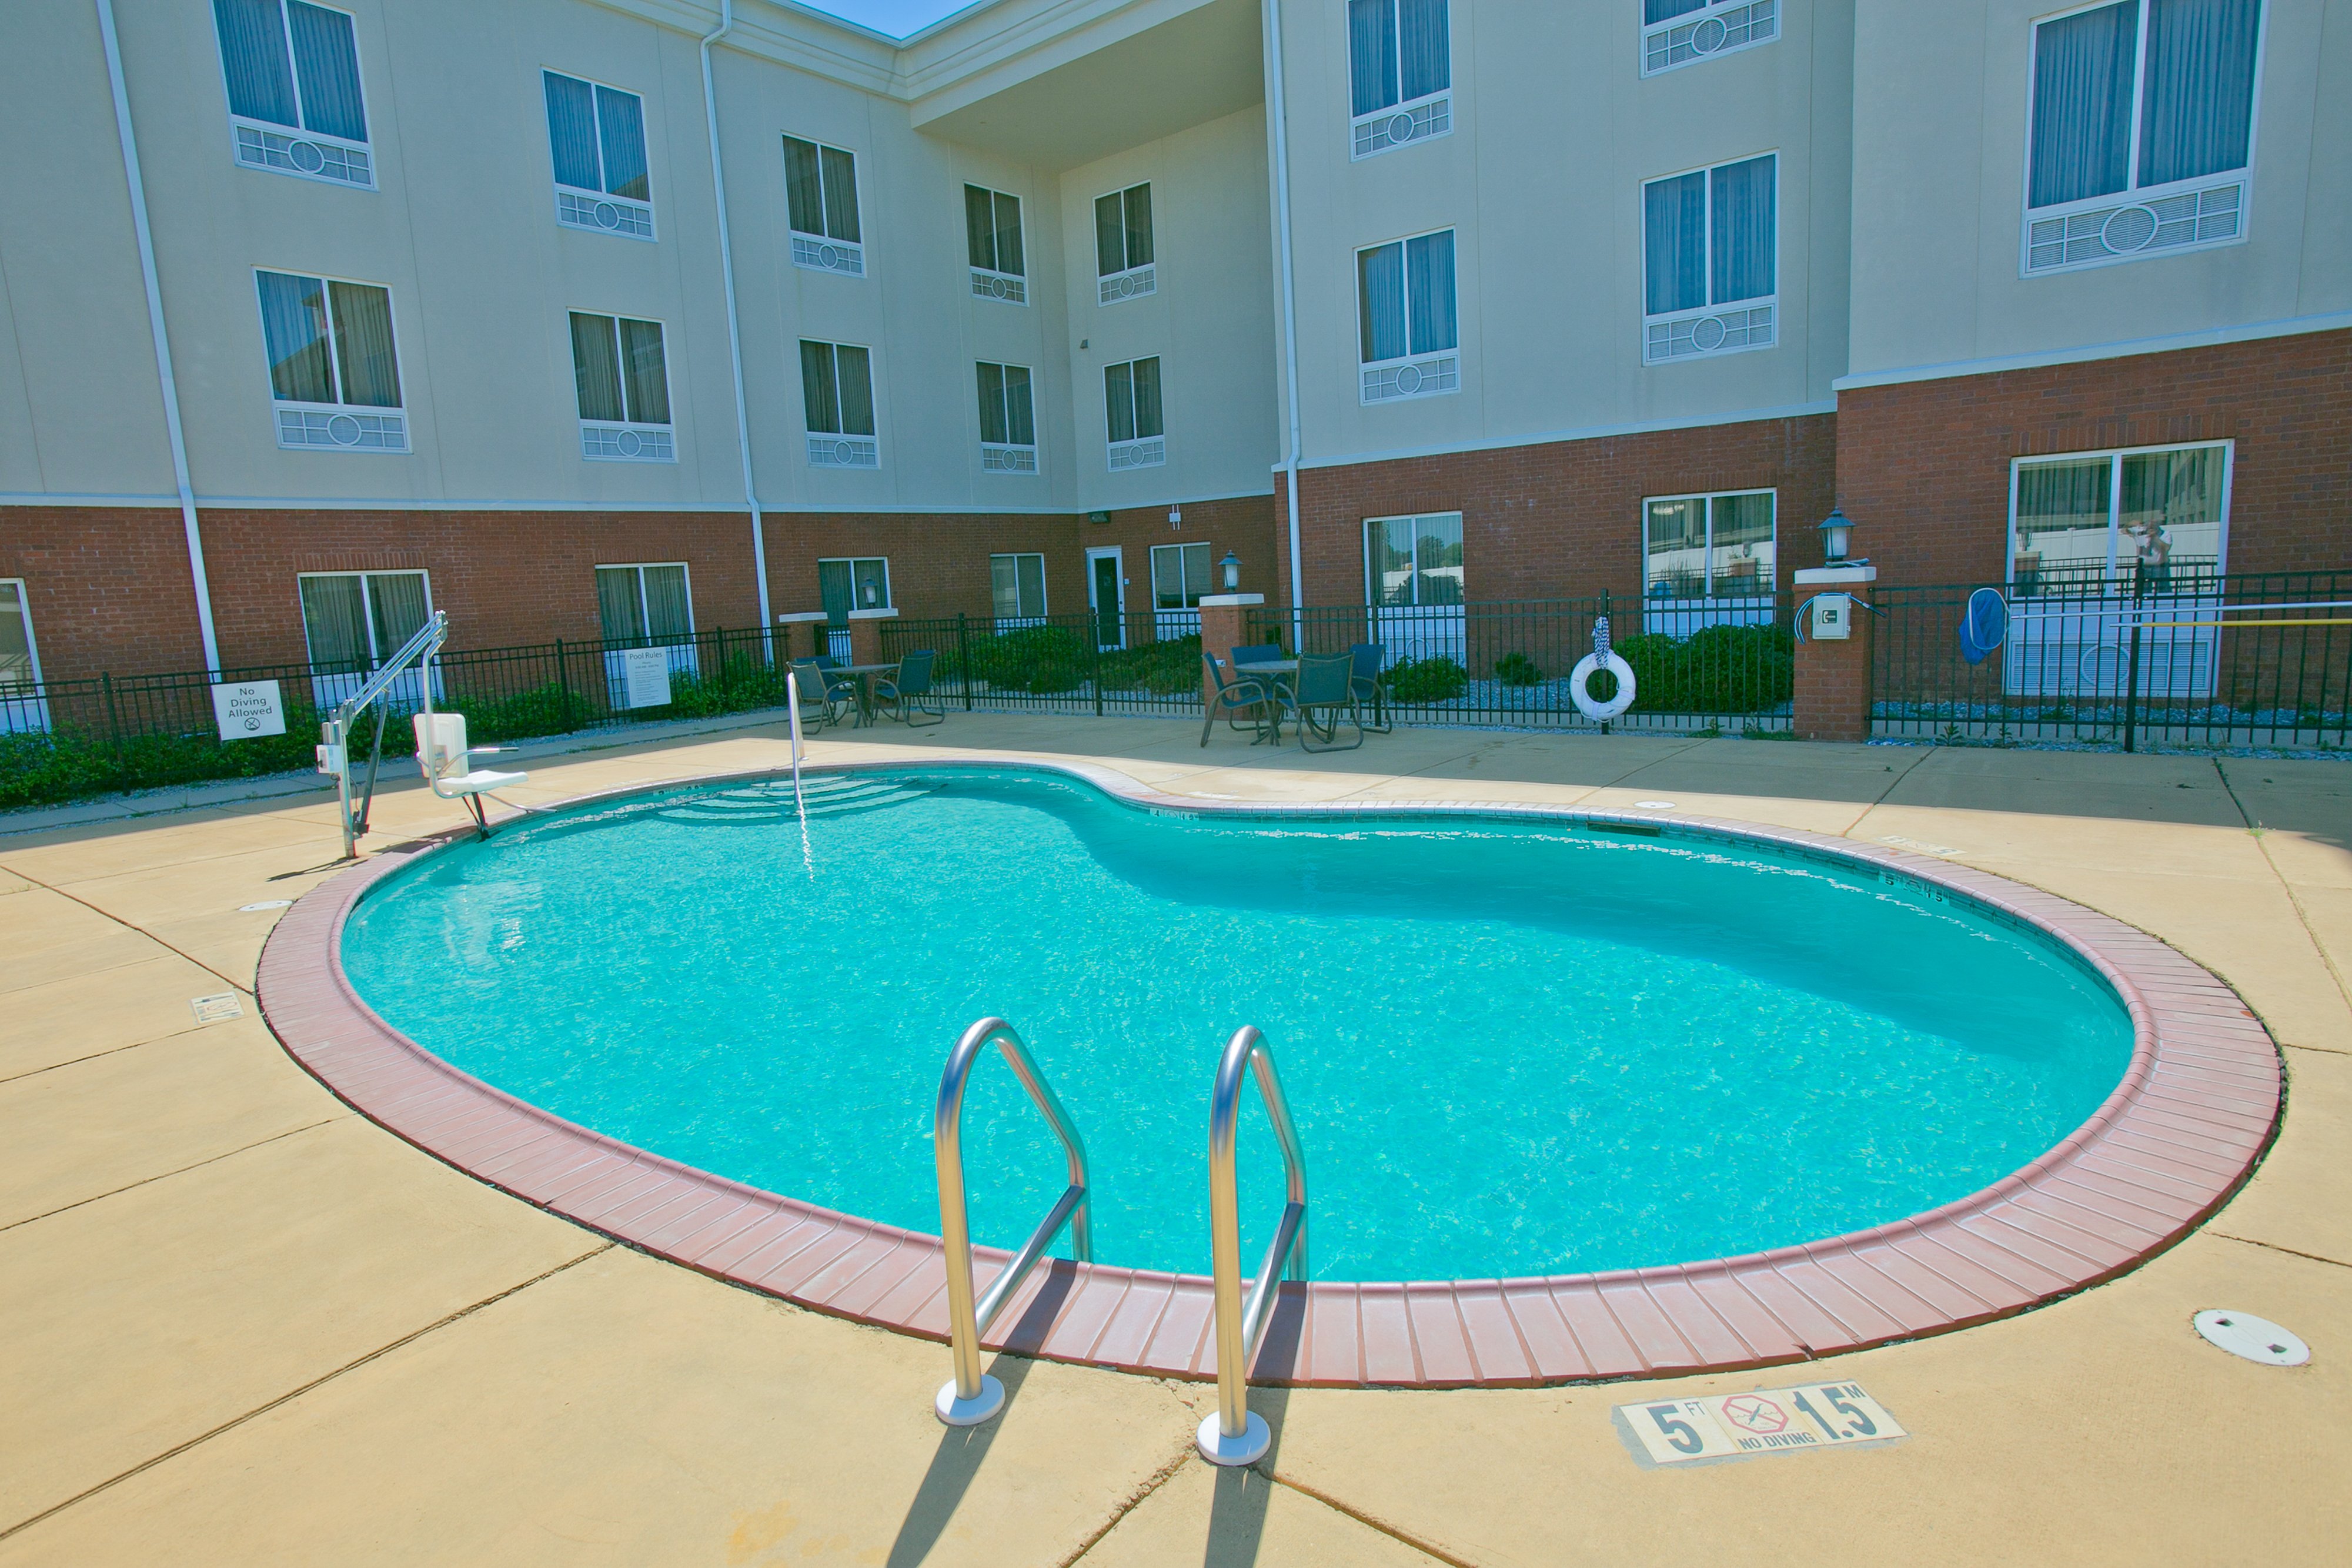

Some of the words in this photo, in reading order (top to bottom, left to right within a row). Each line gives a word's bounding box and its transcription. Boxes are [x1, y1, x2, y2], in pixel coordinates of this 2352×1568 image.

[230, 698, 266, 707] Diving
[228, 706, 272, 718] Allowed
[1792, 1386, 1877, 1440] 1.5
[1842, 1385, 1866, 1399] M
[1646, 1404, 1703, 1453] 5
[1683, 1402, 1705, 1416] FT
[1736, 1437, 1762, 1450] NO
[1762, 1432, 1817, 1447] DIVING
